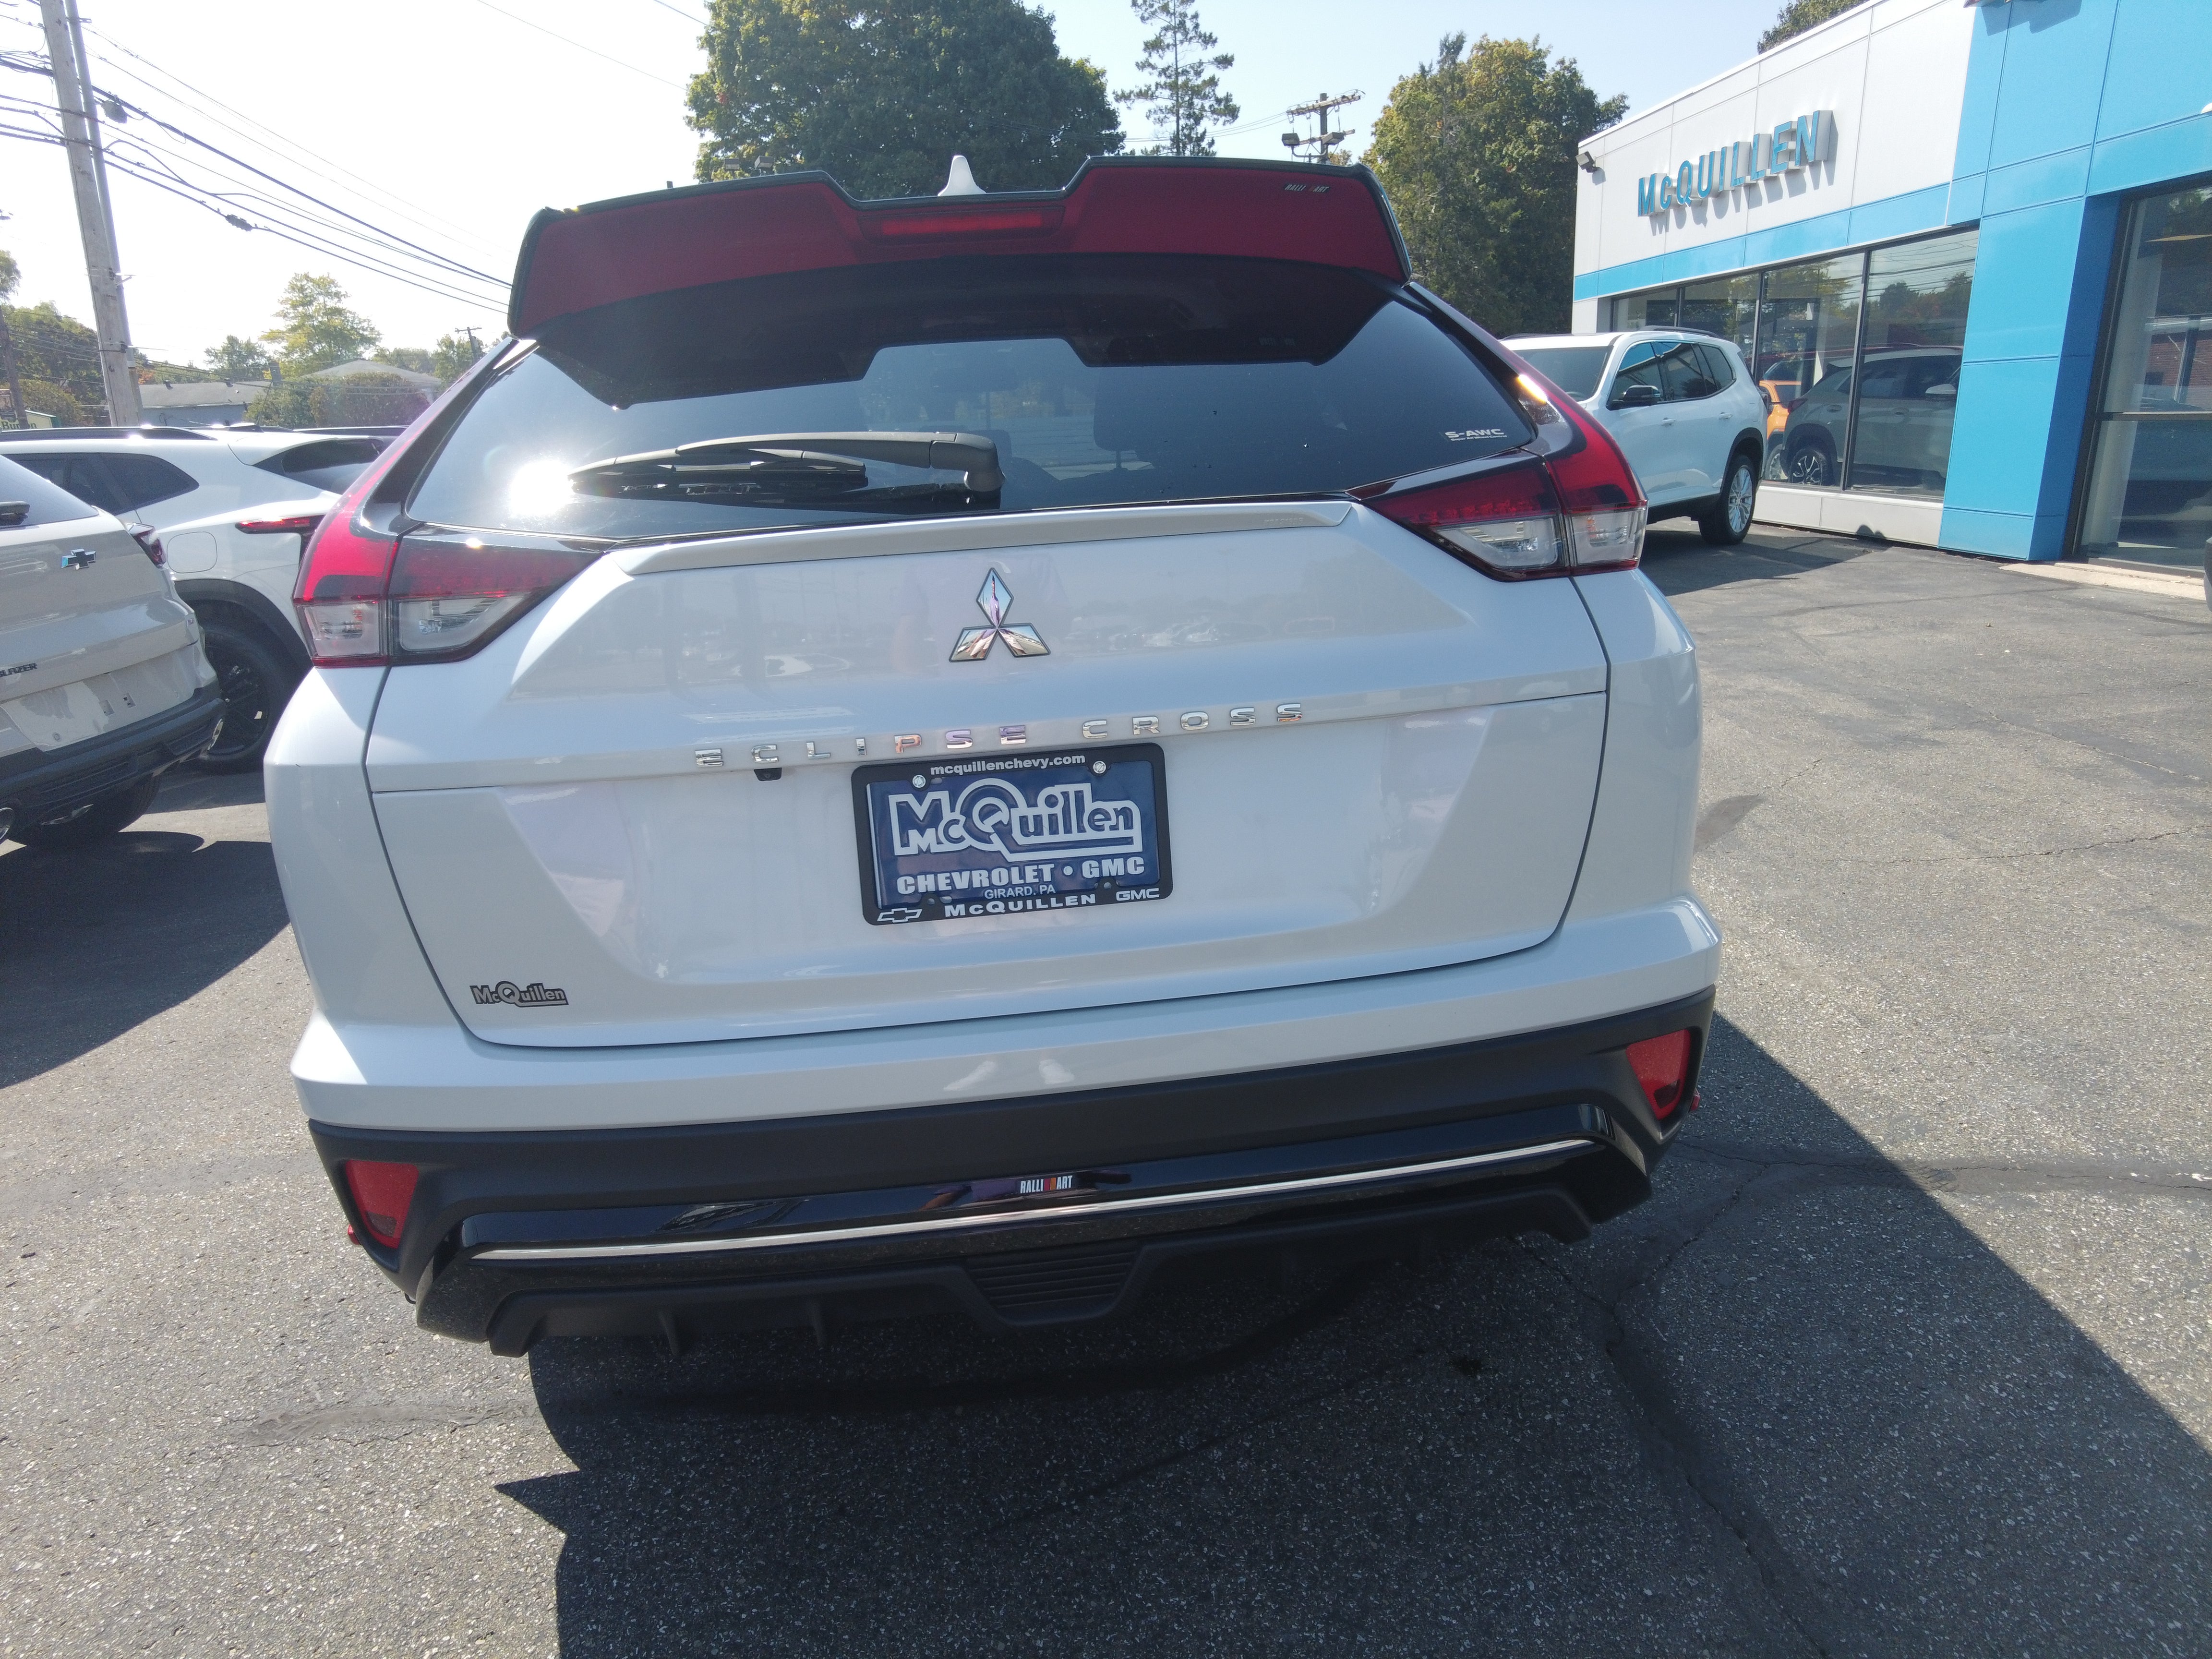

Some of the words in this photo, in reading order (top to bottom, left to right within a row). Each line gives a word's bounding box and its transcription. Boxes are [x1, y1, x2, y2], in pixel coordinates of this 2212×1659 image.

[1, 421, 37, 430] Burn
[1445, 429, 1504, 439] S-AWC
[695, 724, 1026, 767] ECLIPSE
[1082, 703, 1302, 739] CROSS
[930, 754, 1086, 775] mcquillenchevy.com
[888, 778, 1143, 863] McQuillen
[896, 864, 1055, 895] CHEVROLET
[1082, 856, 1145, 879] GMC
[1039, 883, 1056, 895] PA
[1116, 888, 1160, 902] GMC
[469, 980, 569, 1008] McQuillen
